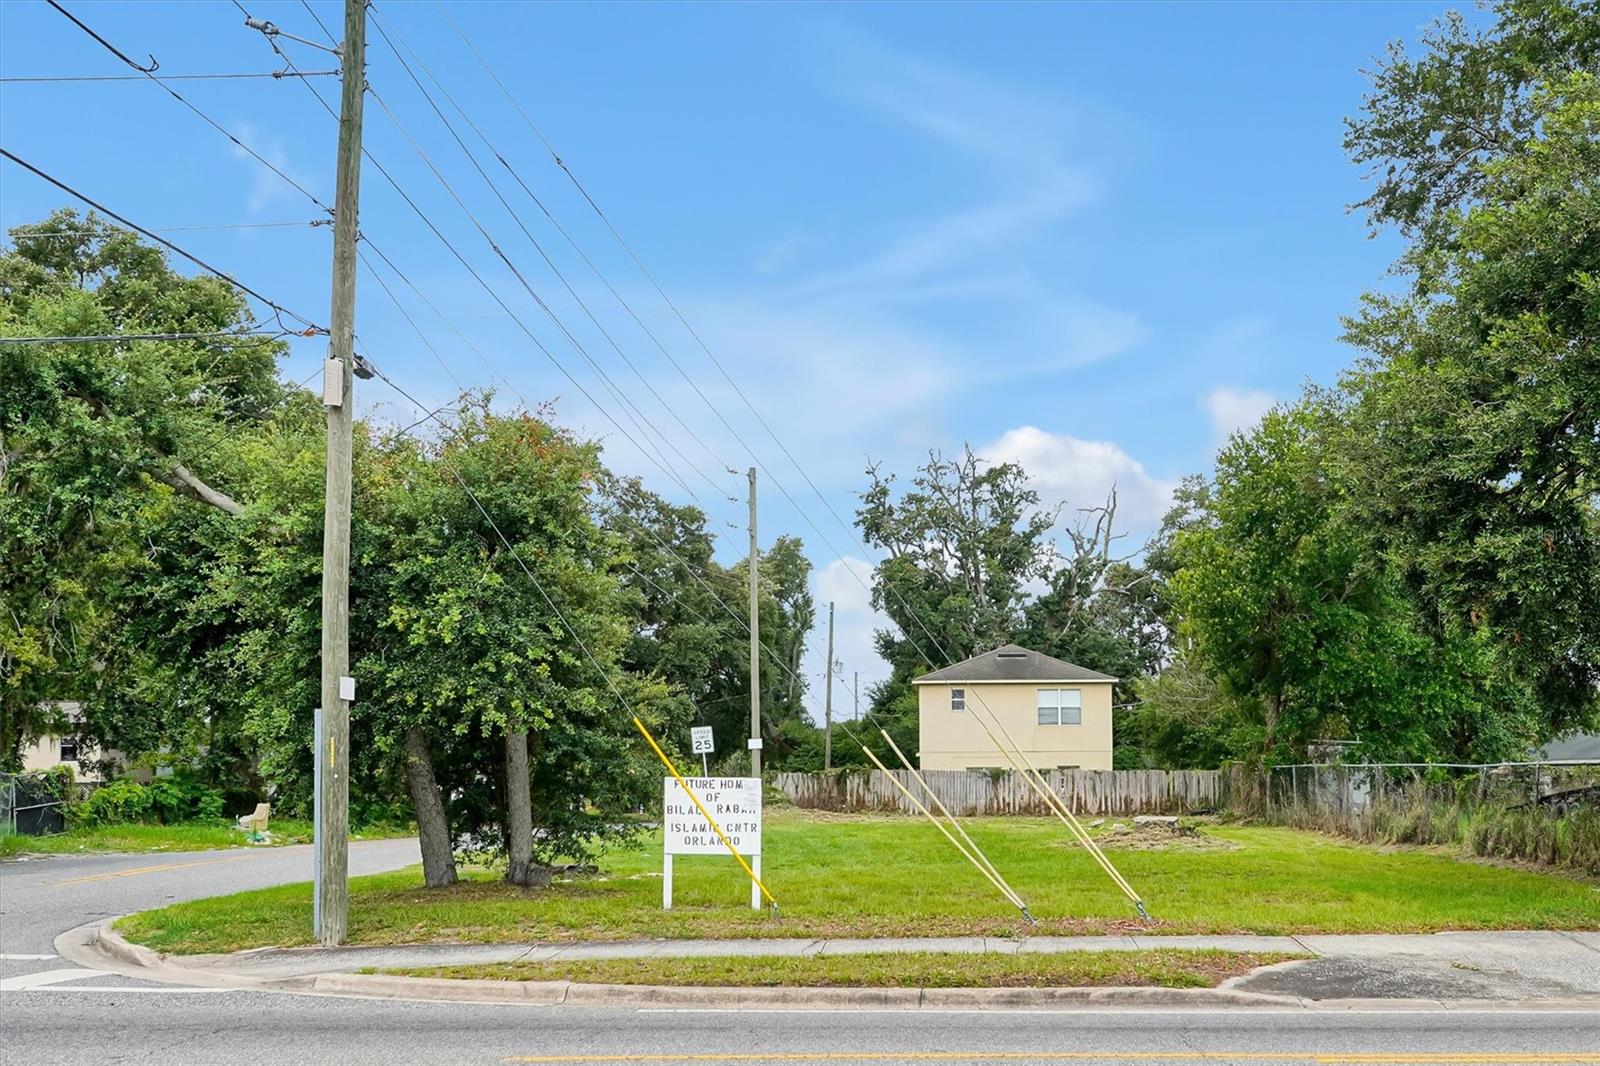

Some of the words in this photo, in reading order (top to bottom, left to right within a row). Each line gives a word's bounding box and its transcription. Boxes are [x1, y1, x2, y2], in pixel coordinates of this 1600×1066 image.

[695, 740, 712, 750] 25
[706, 792, 720, 802] OF
[726, 823, 758, 833] CNTR
